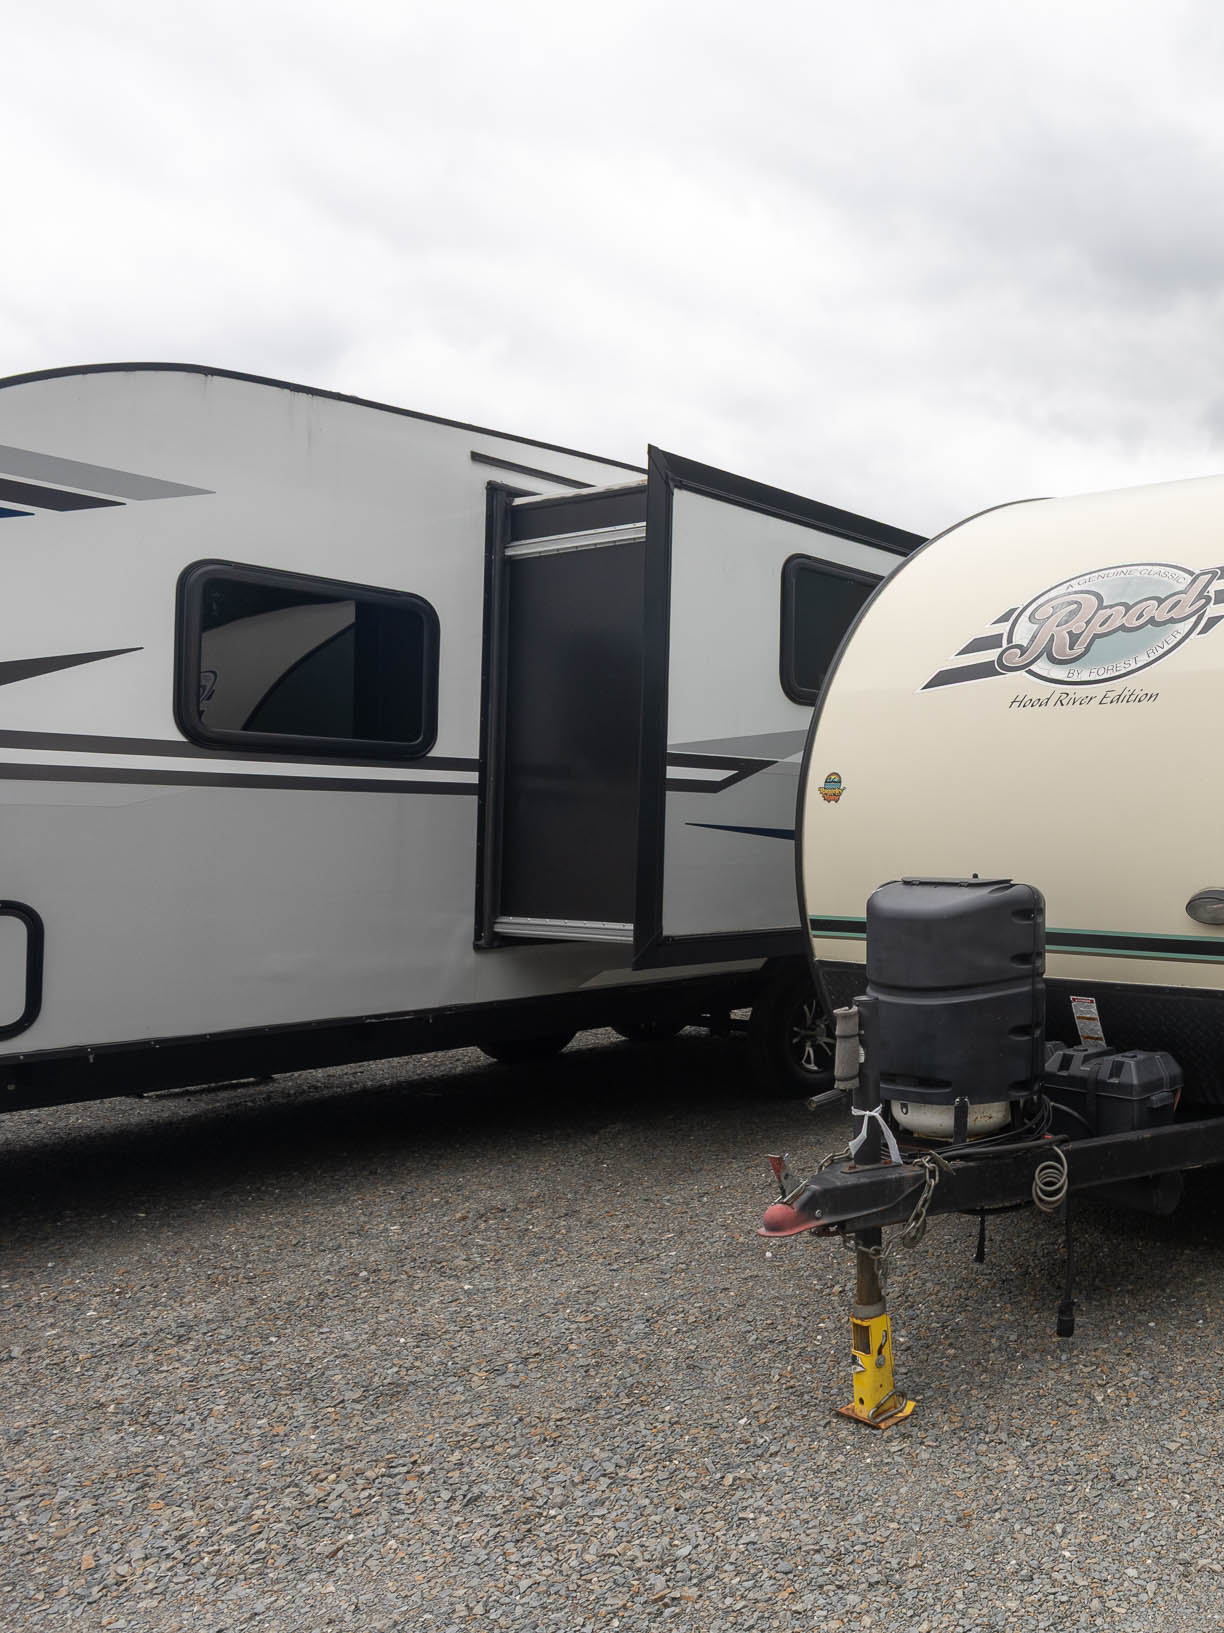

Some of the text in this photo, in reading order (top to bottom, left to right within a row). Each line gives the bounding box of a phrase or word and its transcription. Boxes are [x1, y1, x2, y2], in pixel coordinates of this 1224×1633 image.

[1139, 568, 1186, 584] CLASSIC
[1066, 629, 1182, 678] BY FOREST RIVER
[1009, 686, 1160, 709] Hood River Edition
